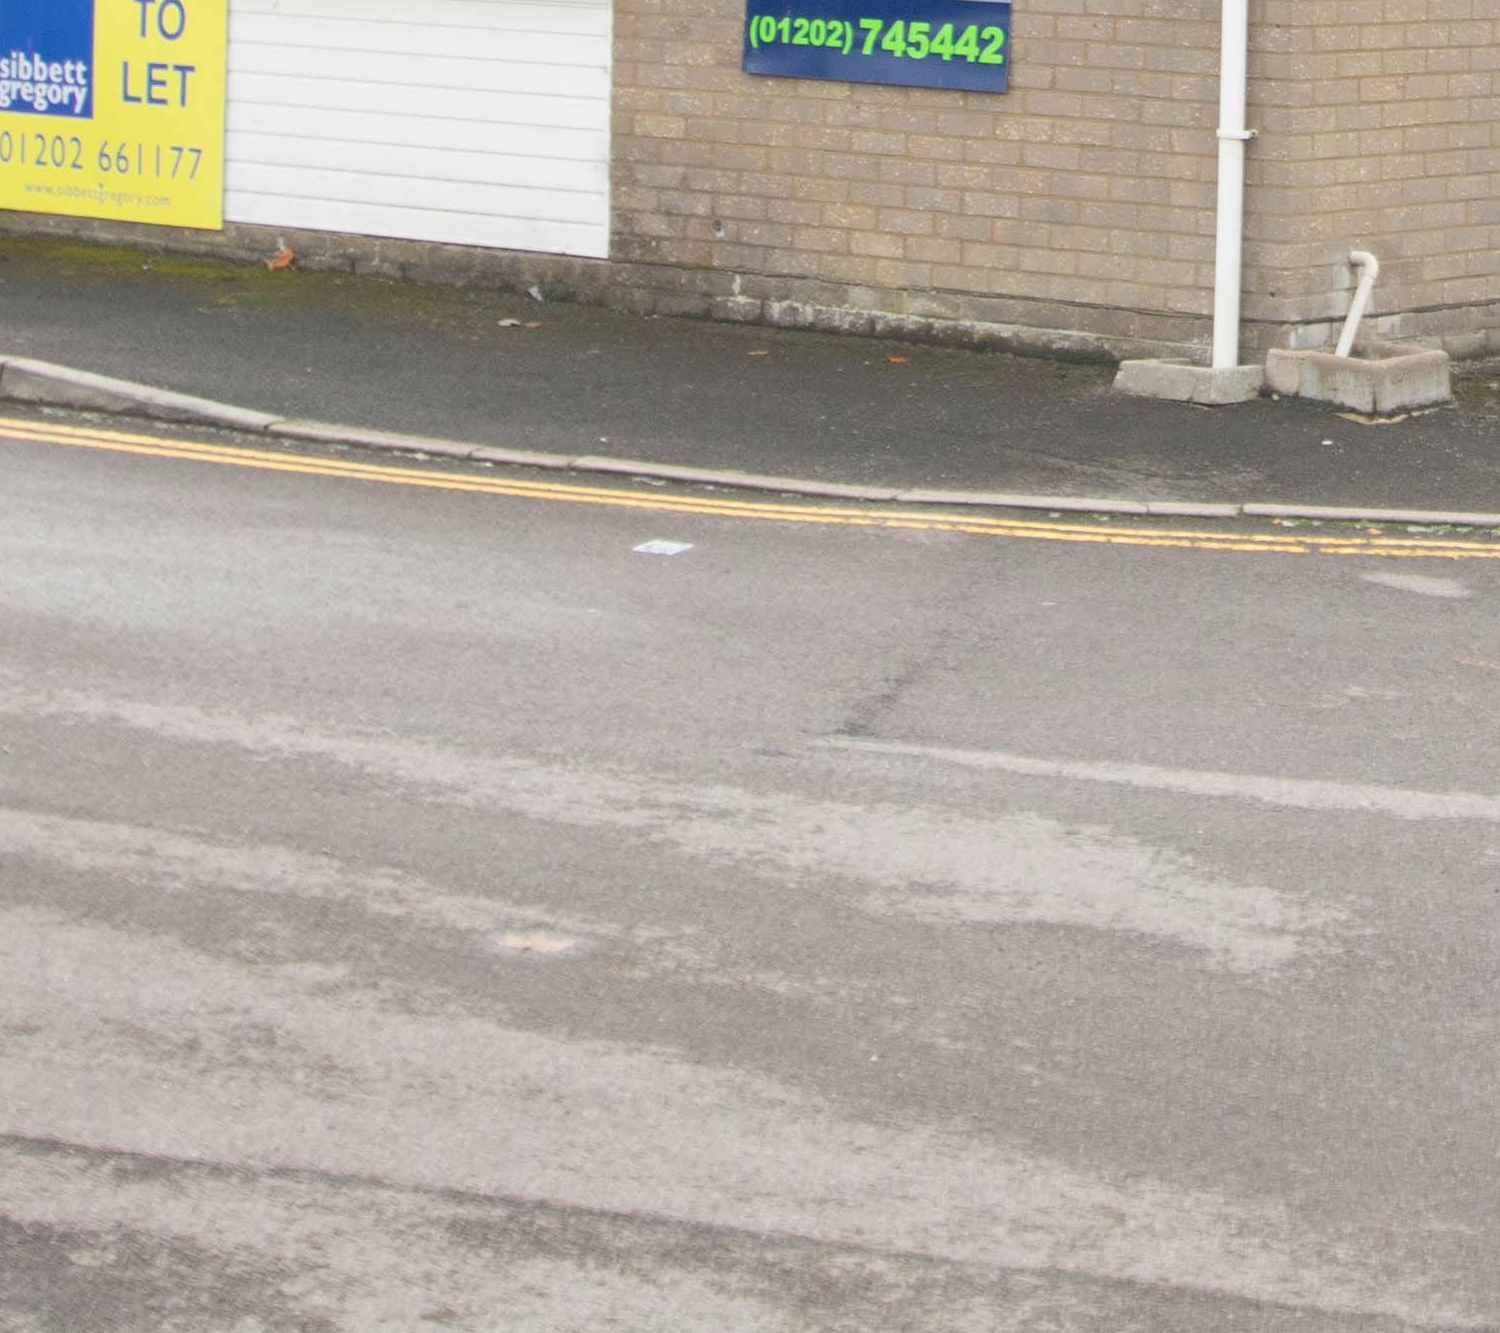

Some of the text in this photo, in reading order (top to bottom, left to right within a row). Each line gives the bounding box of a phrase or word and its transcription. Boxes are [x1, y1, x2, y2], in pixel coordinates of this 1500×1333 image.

[749, 15, 1005, 65] (01202) 745442
[0, 53, 87, 85] sibbett
[122, 62, 196, 108] LET
[0, 131, 203, 181] 01202 661177
